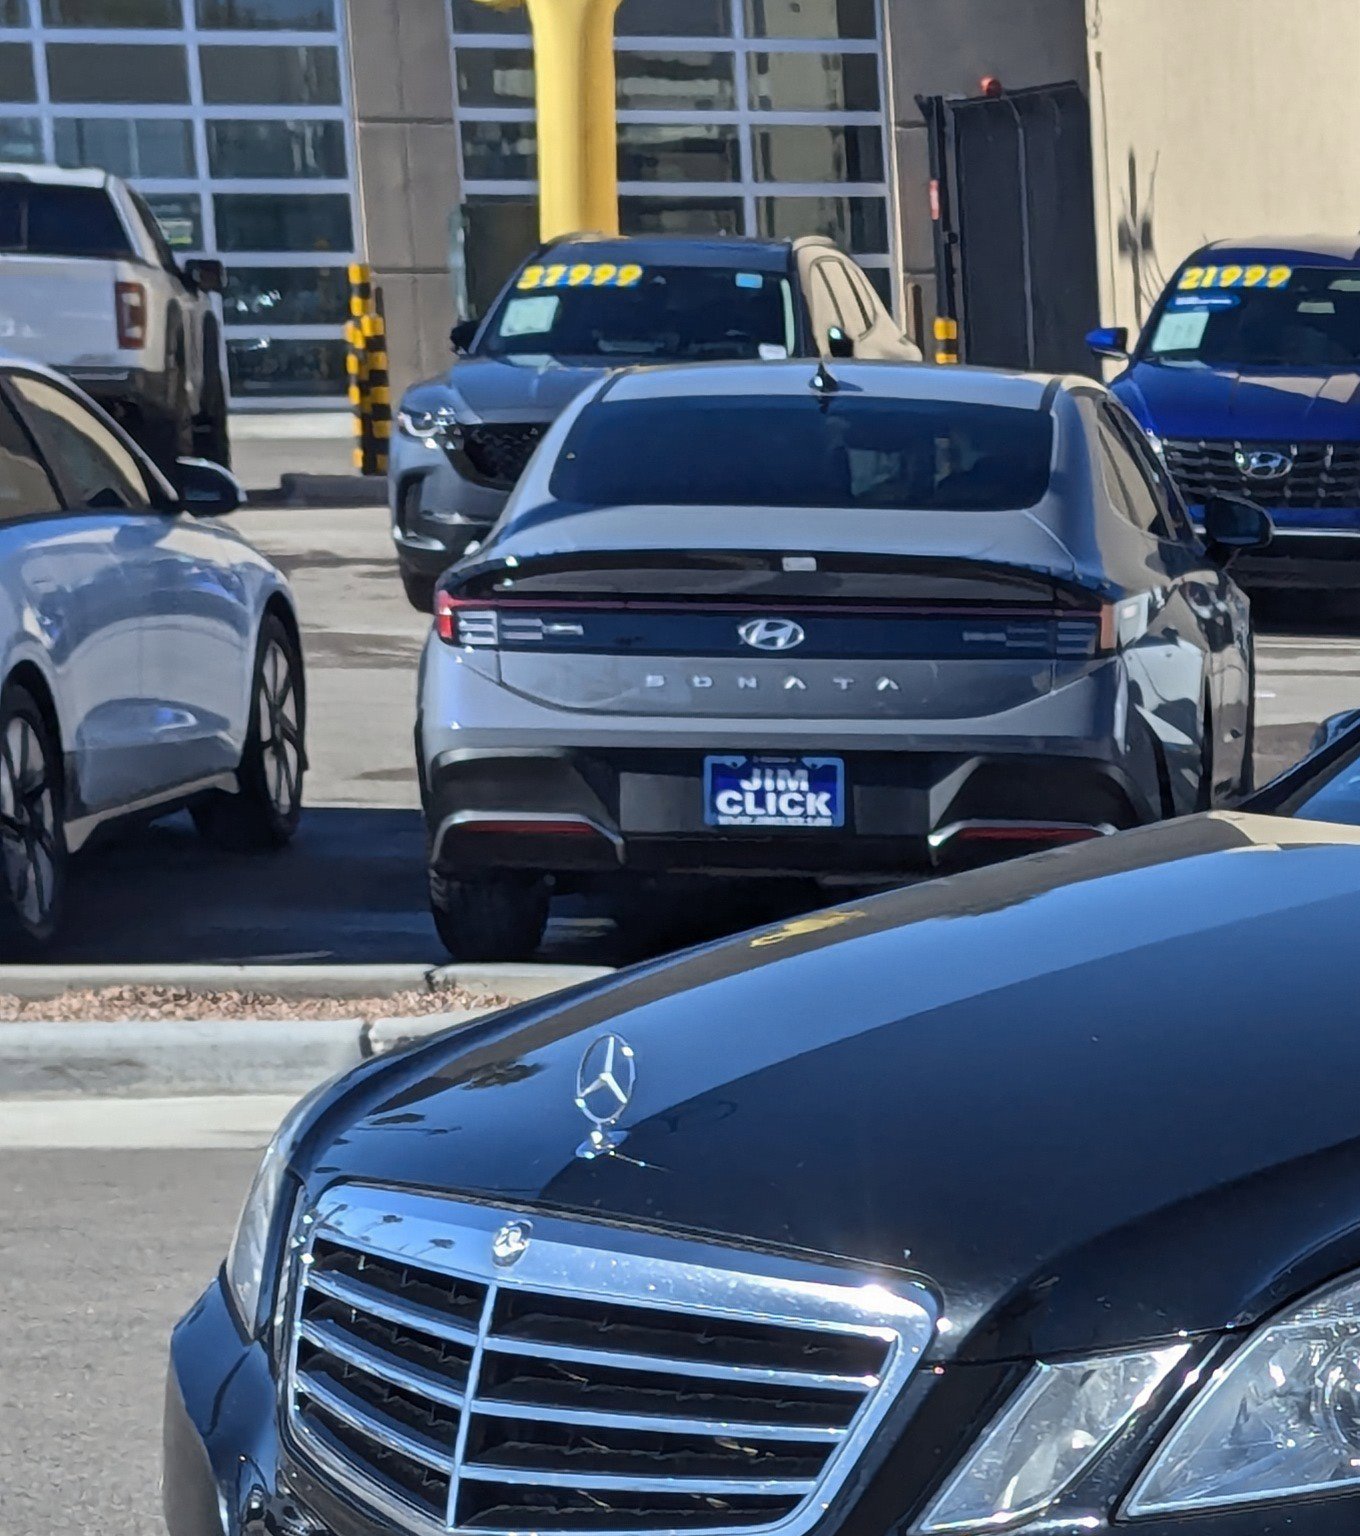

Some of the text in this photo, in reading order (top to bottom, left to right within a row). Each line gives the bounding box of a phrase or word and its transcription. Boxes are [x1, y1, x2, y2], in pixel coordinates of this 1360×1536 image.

[1177, 265, 1292, 290] 21999
[645, 674, 900, 690] SONATA
[739, 768, 810, 792] JIM
[715, 789, 832, 816] CLICK
